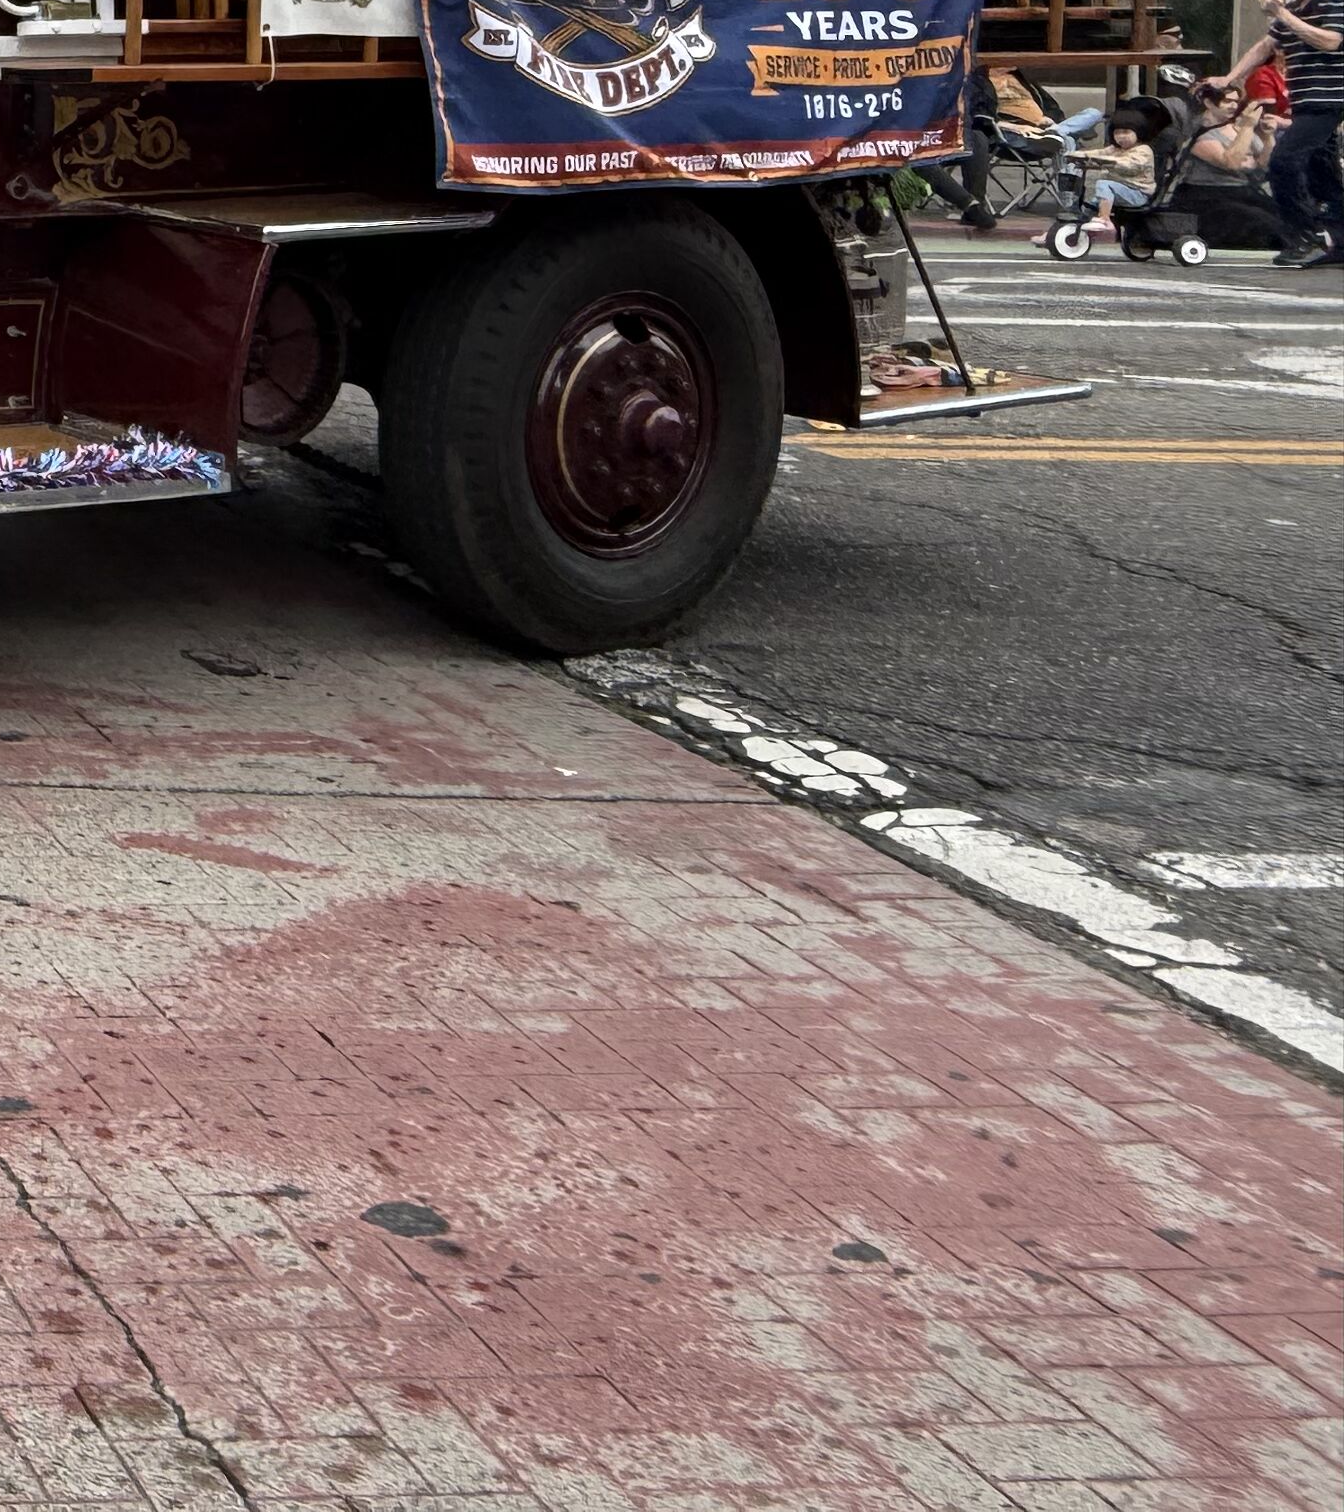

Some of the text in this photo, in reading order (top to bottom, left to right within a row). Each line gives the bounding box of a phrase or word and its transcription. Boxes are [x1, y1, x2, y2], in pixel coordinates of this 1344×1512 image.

[786, 9, 919, 41] YEARS
[597, 45, 687, 107] DEPT.
[765, 54, 821, 79] SERVICE
[832, 56, 872, 80] PRIDE
[804, 88, 903, 119] 1876-26
[564, 152, 597, 172] OUR
[601, 150, 639, 170] PAST
